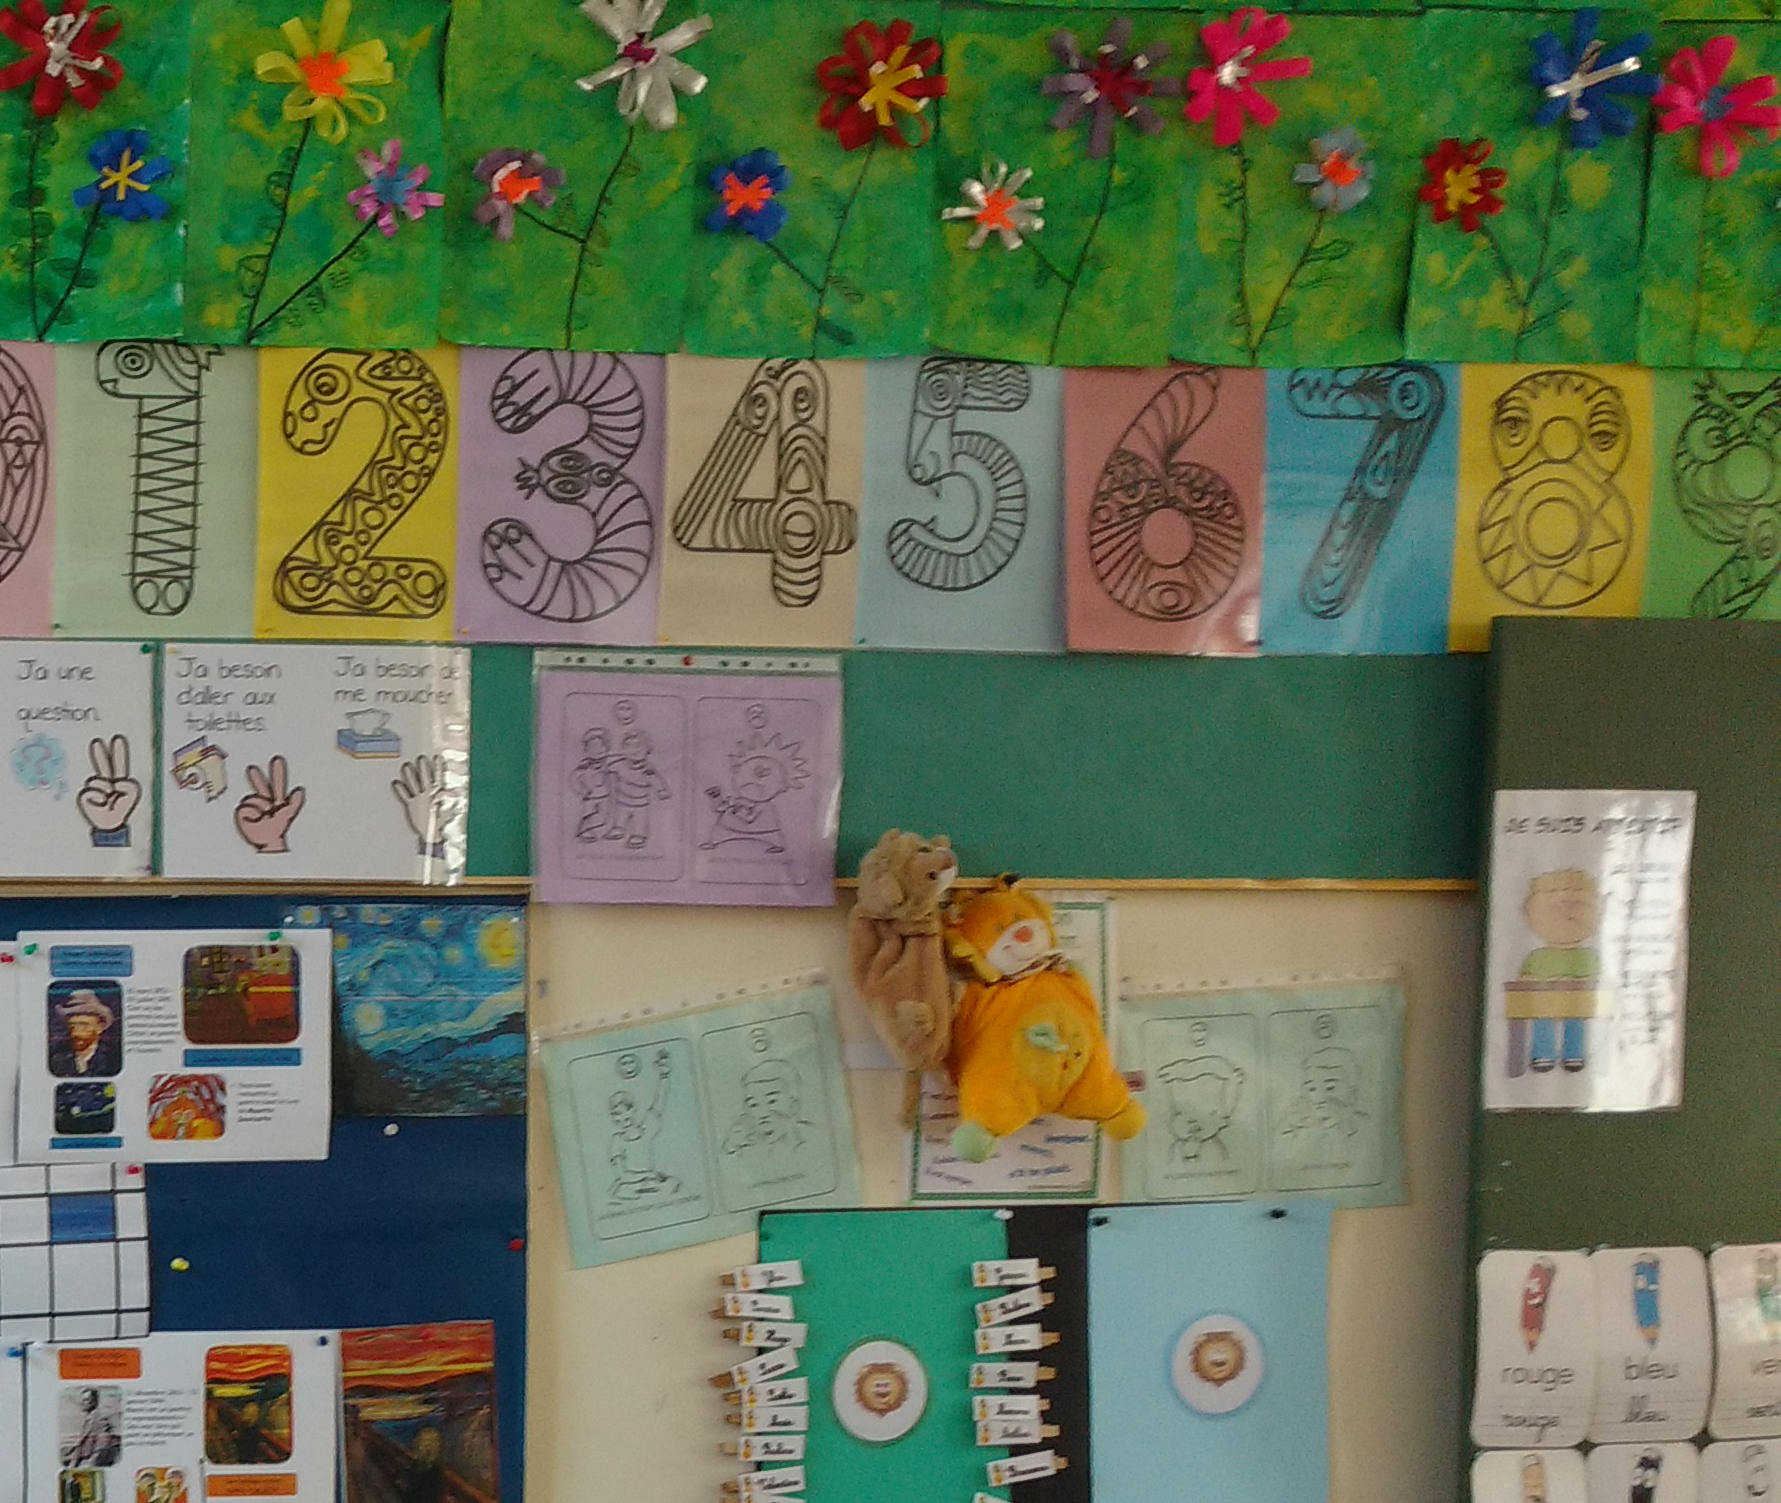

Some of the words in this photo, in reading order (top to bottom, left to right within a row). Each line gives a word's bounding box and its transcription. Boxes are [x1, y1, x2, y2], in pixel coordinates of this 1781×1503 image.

[272, 346, 449, 619] 2
[479, 346, 656, 624] 3
[672, 355, 858, 607] 4
[885, 355, 1032, 591] 5
[1089, 366, 1245, 621] 6
[1289, 362, 1447, 618] 7
[1477, 368, 1633, 610] 8
[58, 665, 95, 681] une
[218, 658, 282, 679] besoin
[243, 689, 277, 706] aux
[334, 686, 367, 702] me
[1501, 1364, 1576, 1391] rouge
[1624, 1356, 1679, 1381] bleu
